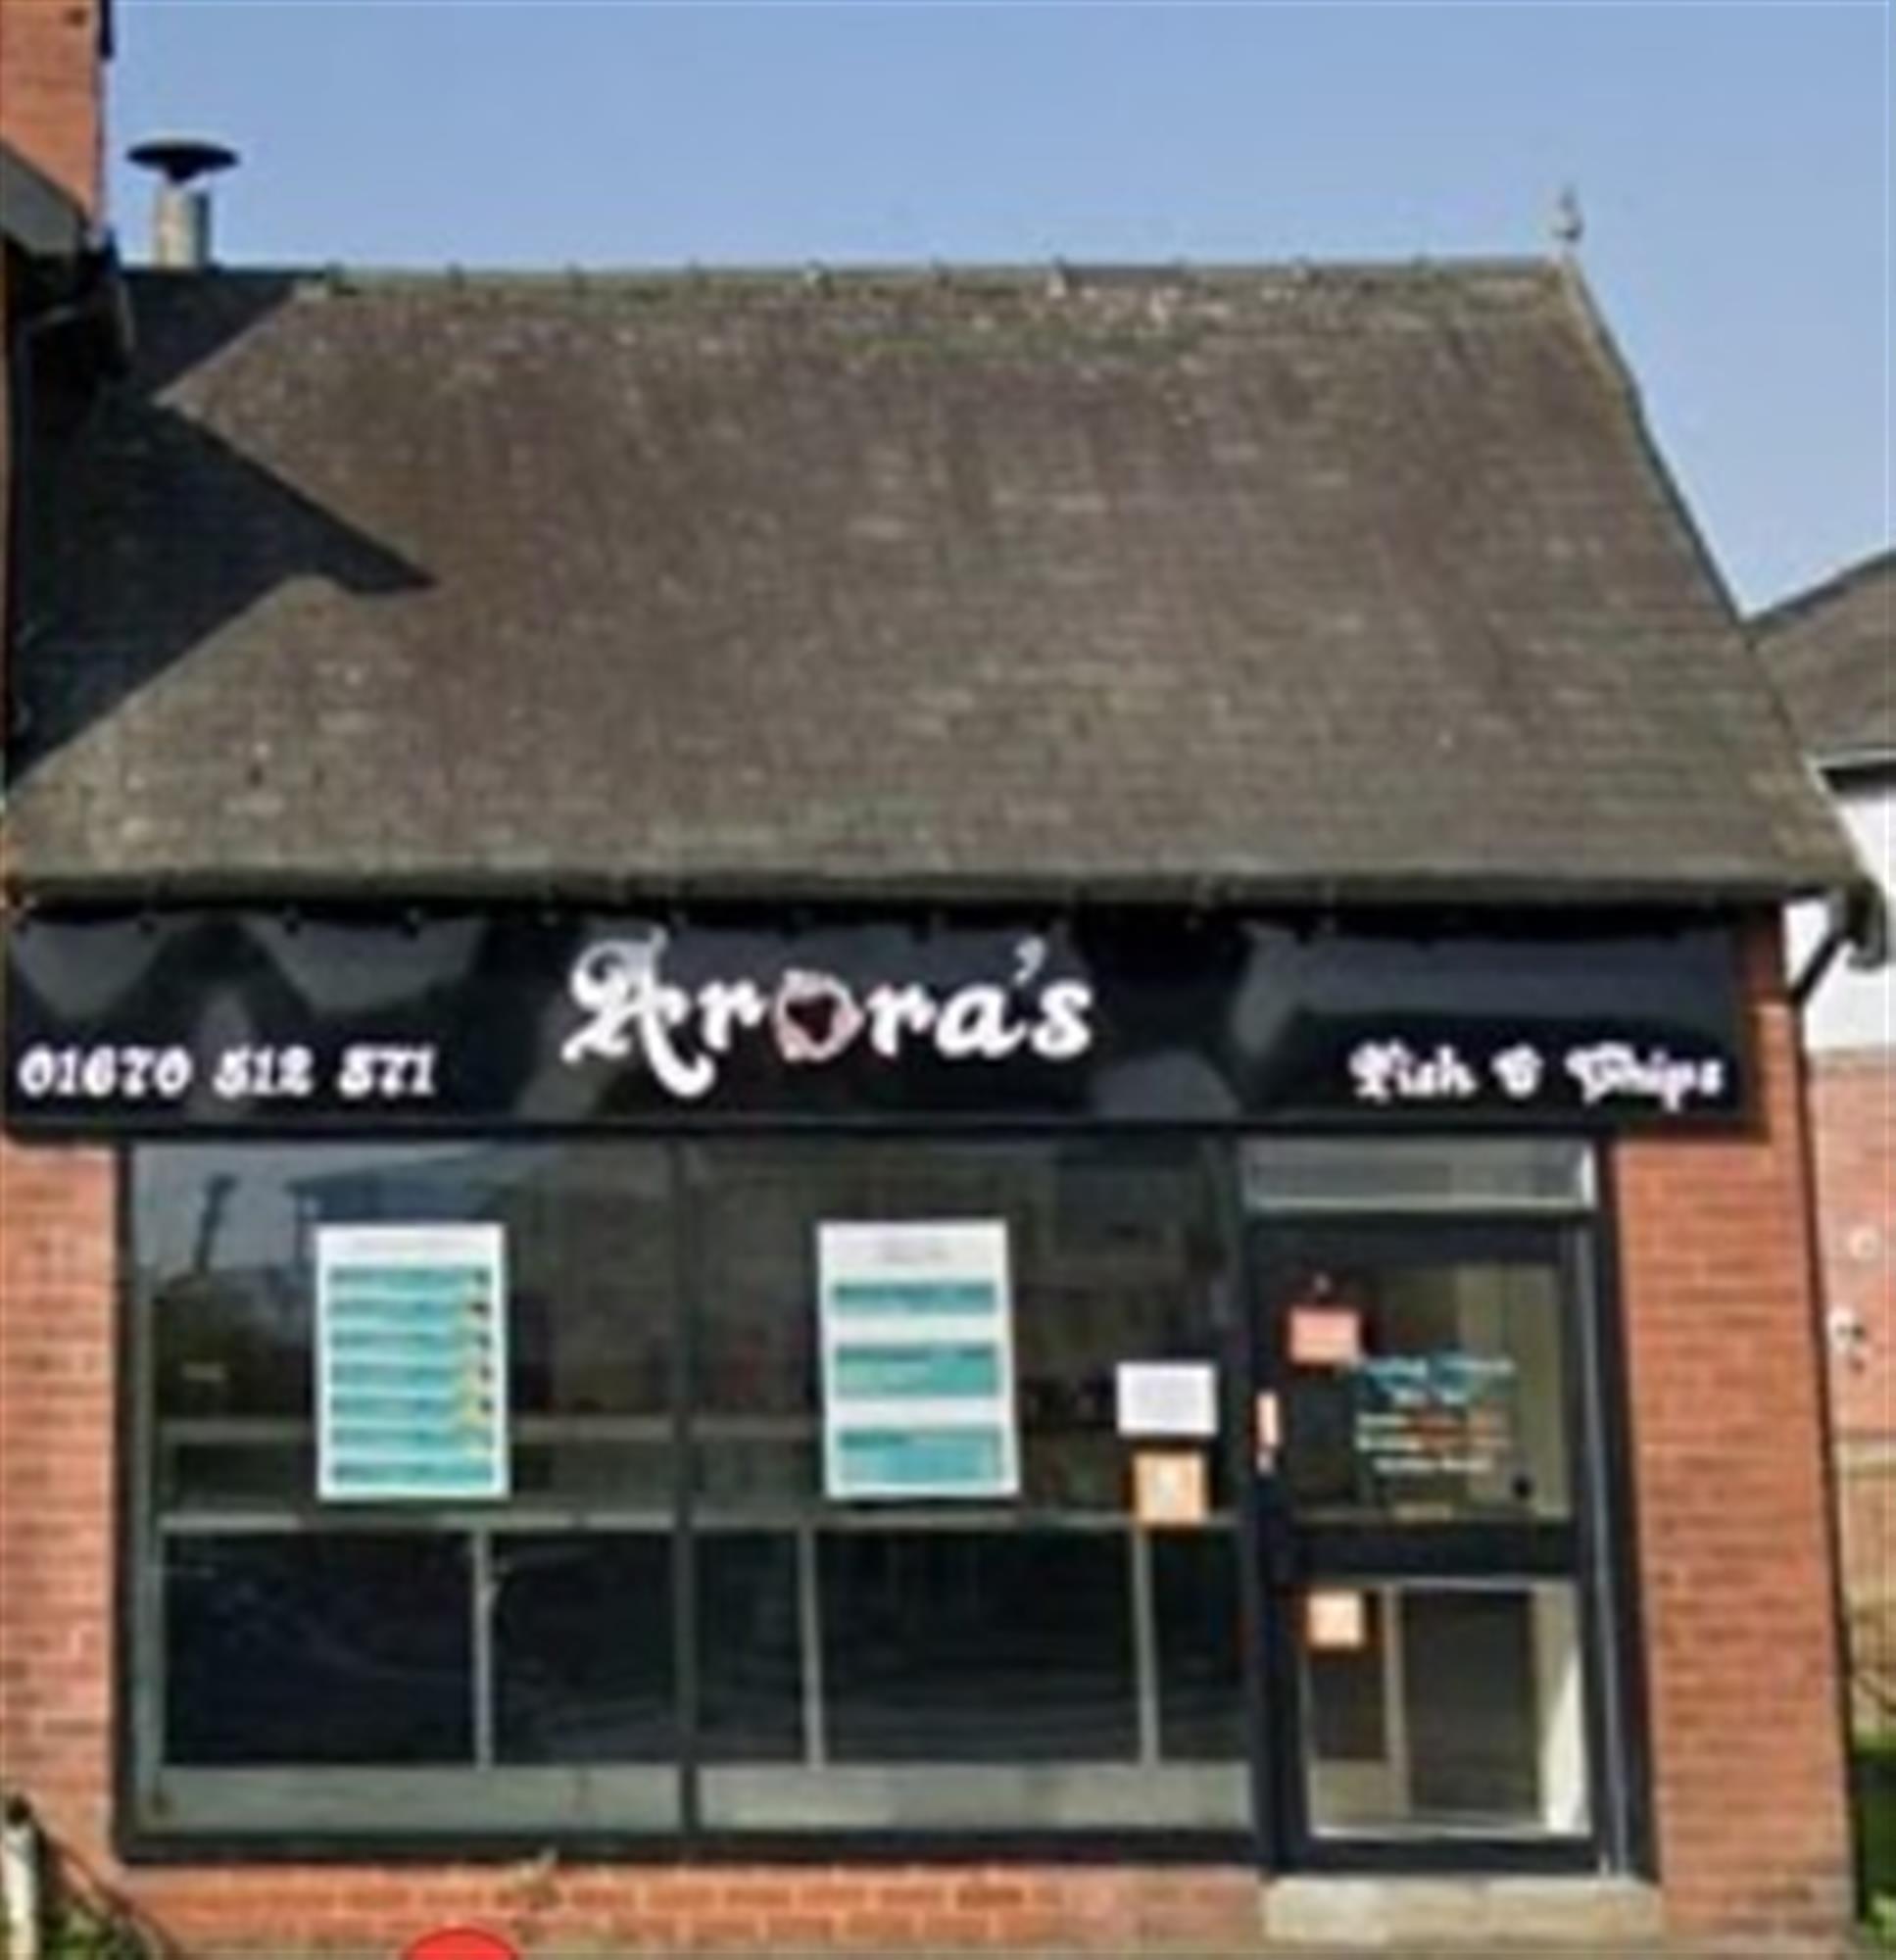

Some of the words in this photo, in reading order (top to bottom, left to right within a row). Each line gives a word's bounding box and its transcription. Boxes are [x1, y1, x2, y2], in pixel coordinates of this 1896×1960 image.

[560, 926, 1093, 1098] Arora's
[18, 1043, 193, 1099] 01670
[213, 1043, 314, 1099] 512
[337, 1043, 436, 1099] 571
